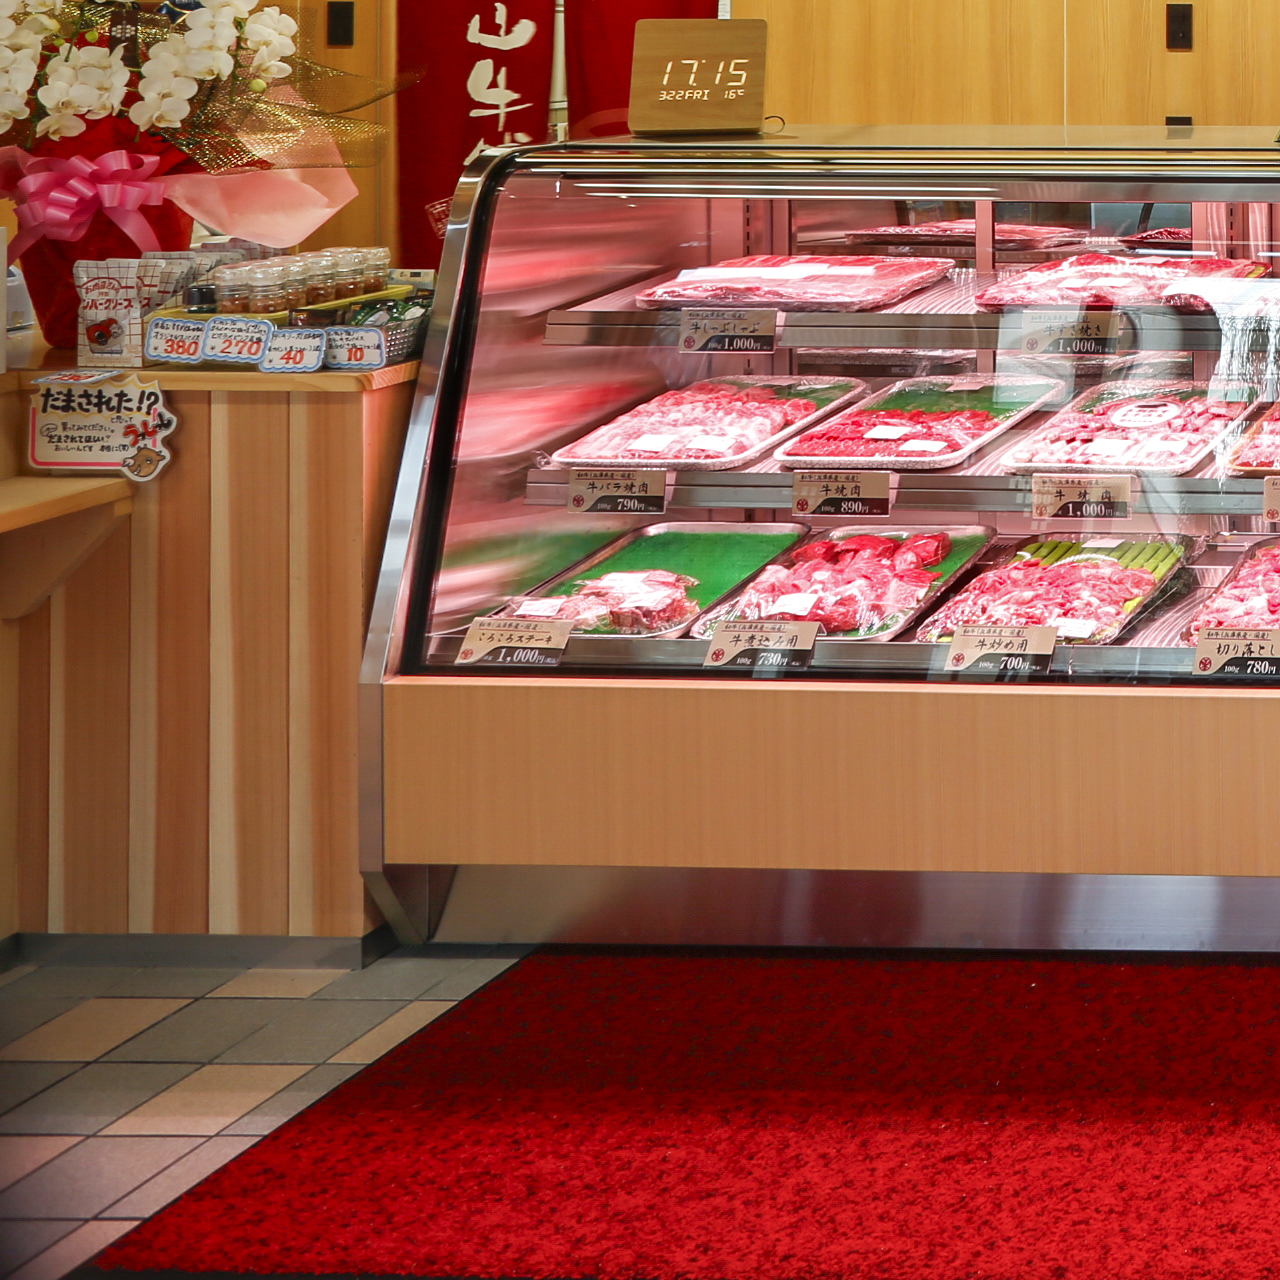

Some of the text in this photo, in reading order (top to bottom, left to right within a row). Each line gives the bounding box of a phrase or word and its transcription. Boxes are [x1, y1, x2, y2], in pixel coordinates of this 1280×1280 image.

[662, 59, 749, 86] 17:15
[690, 322, 760, 333] 牛しゃぶしゃぶ
[1044, 324, 1101, 336] 牛すき焼き
[164, 339, 199, 356] 380
[220, 339, 262, 356] 270
[724, 338, 760, 350] 1,000円
[1058, 340, 1102, 352] 1,000円
[279, 349, 304, 364] 40
[347, 348, 364, 362] 10
[41, 387, 159, 415] だまされた!?
[110, 416, 133, 424] と思って
[61, 422, 115, 433] 買ってみてください。
[587, 482, 648, 494] 牛バラ焼肉
[820, 484, 860, 497] 牛焼肉
[1054, 489, 1111, 502] 牛焼肉
[617, 498, 644, 510] 790円
[841, 501, 869, 513] 890円
[1068, 504, 1112, 516] 1,000円
[478, 633, 552, 644] ころころステーキ
[730, 634, 798, 647] 牛煮込み用
[975, 638, 1028, 652] 牛炒め用
[1217, 642, 1274, 656] 切り落とし
[496, 649, 544, 663] 1,000円
[758, 652, 788, 666] 730円
[1000, 656, 1030, 670] 700円
[1246, 661, 1276, 674] 780円
